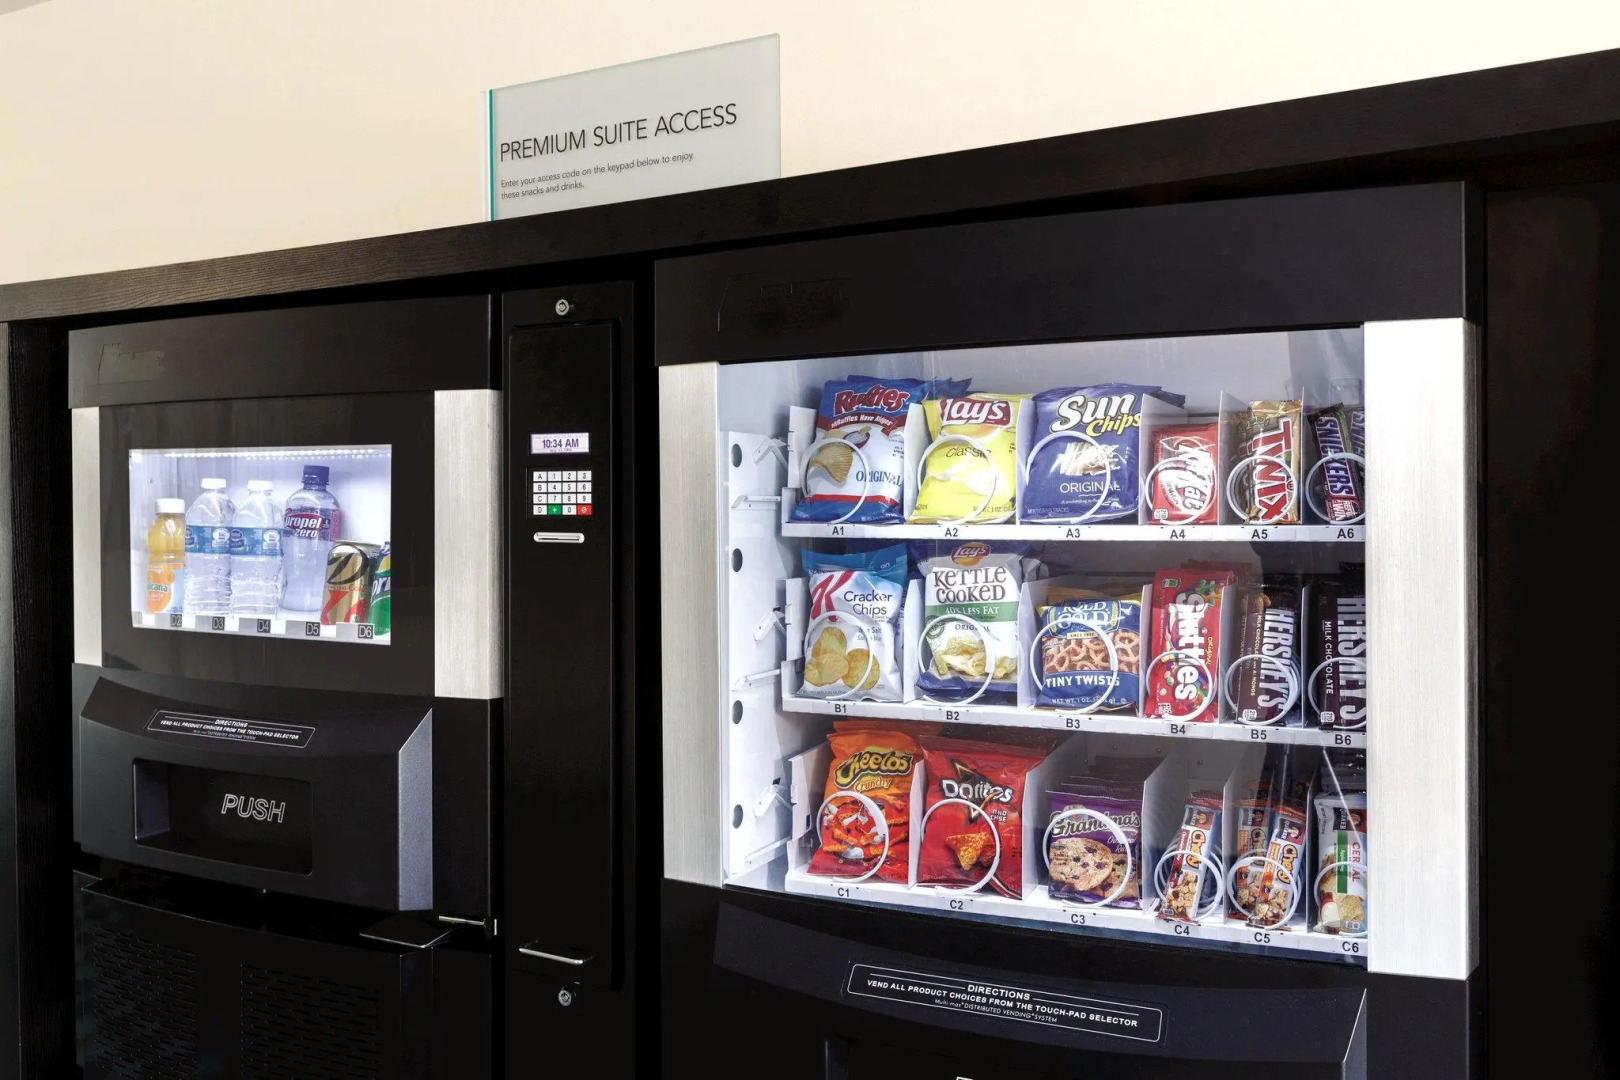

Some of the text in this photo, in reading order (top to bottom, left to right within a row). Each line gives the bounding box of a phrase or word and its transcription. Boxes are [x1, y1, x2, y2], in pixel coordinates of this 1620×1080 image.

[500, 103, 737, 162] PREMIUM SUITE ACCESS
[501, 152, 693, 188] Enter your access code on the keypad below to enjoy
[501, 180, 584, 200] these snacks and drinks.
[834, 383, 911, 417] Ruffles
[1050, 393, 1136, 432] Sun
[542, 438, 579, 449] 10:34 AM
[285, 516, 322, 529] propel
[294, 528, 319, 538] zero
[831, 526, 845, 536] A1
[944, 527, 958, 537] A2
[1065, 528, 1081, 538] A3
[1169, 529, 1186, 539] A4
[1251, 529, 1268, 539] A5
[1337, 528, 1354, 539] A6
[843, 589, 892, 603] Cracker
[852, 603, 887, 620] Chips
[962, 607, 980, 615] LESS
[983, 605, 1000, 615] FAT
[171, 615, 182, 626] D2
[213, 616, 224, 627] D3
[258, 619, 270, 631] D4
[306, 623, 319, 635] D5
[359, 625, 372, 637] D6
[1257, 608, 1294, 709] HERSHEY'S
[1324, 621, 1334, 695] MILK CHOCOLATE
[1045, 675, 1120, 688] TINY TWISTS
[834, 703, 847, 714] B1
[946, 710, 960, 721] B2
[214, 719, 248, 728] DIRECTIONS
[1066, 718, 1081, 729] B3
[1170, 723, 1186, 735] B4
[181, 721, 203, 729] PRODUCT
[203, 723, 223, 731] CHOICES
[247, 729, 274, 737] TOUCH-PAD
[273, 732, 299, 740] SELECTOR
[1250, 729, 1267, 740] B5
[1334, 734, 1352, 745] B6
[834, 750, 914, 789] Cheetos
[855, 775, 894, 792] Crunchy
[942, 778, 1015, 803] Doritos
[221, 793, 286, 823] PUSH
[1351, 842, 1361, 882] CERAL
[837, 887, 850, 898] C1
[950, 899, 964, 910] C2
[1071, 913, 1086, 924] C3
[1174, 924, 1190, 935] C4
[1254, 931, 1271, 943] C5
[1342, 941, 1359, 953] C6
[967, 984, 1031, 1001] DIRECTIONS
[867, 979, 1138, 1027] VEND ALL PRODUCT CHOICES FROM THE TOUCH-PAD SELECTOR
